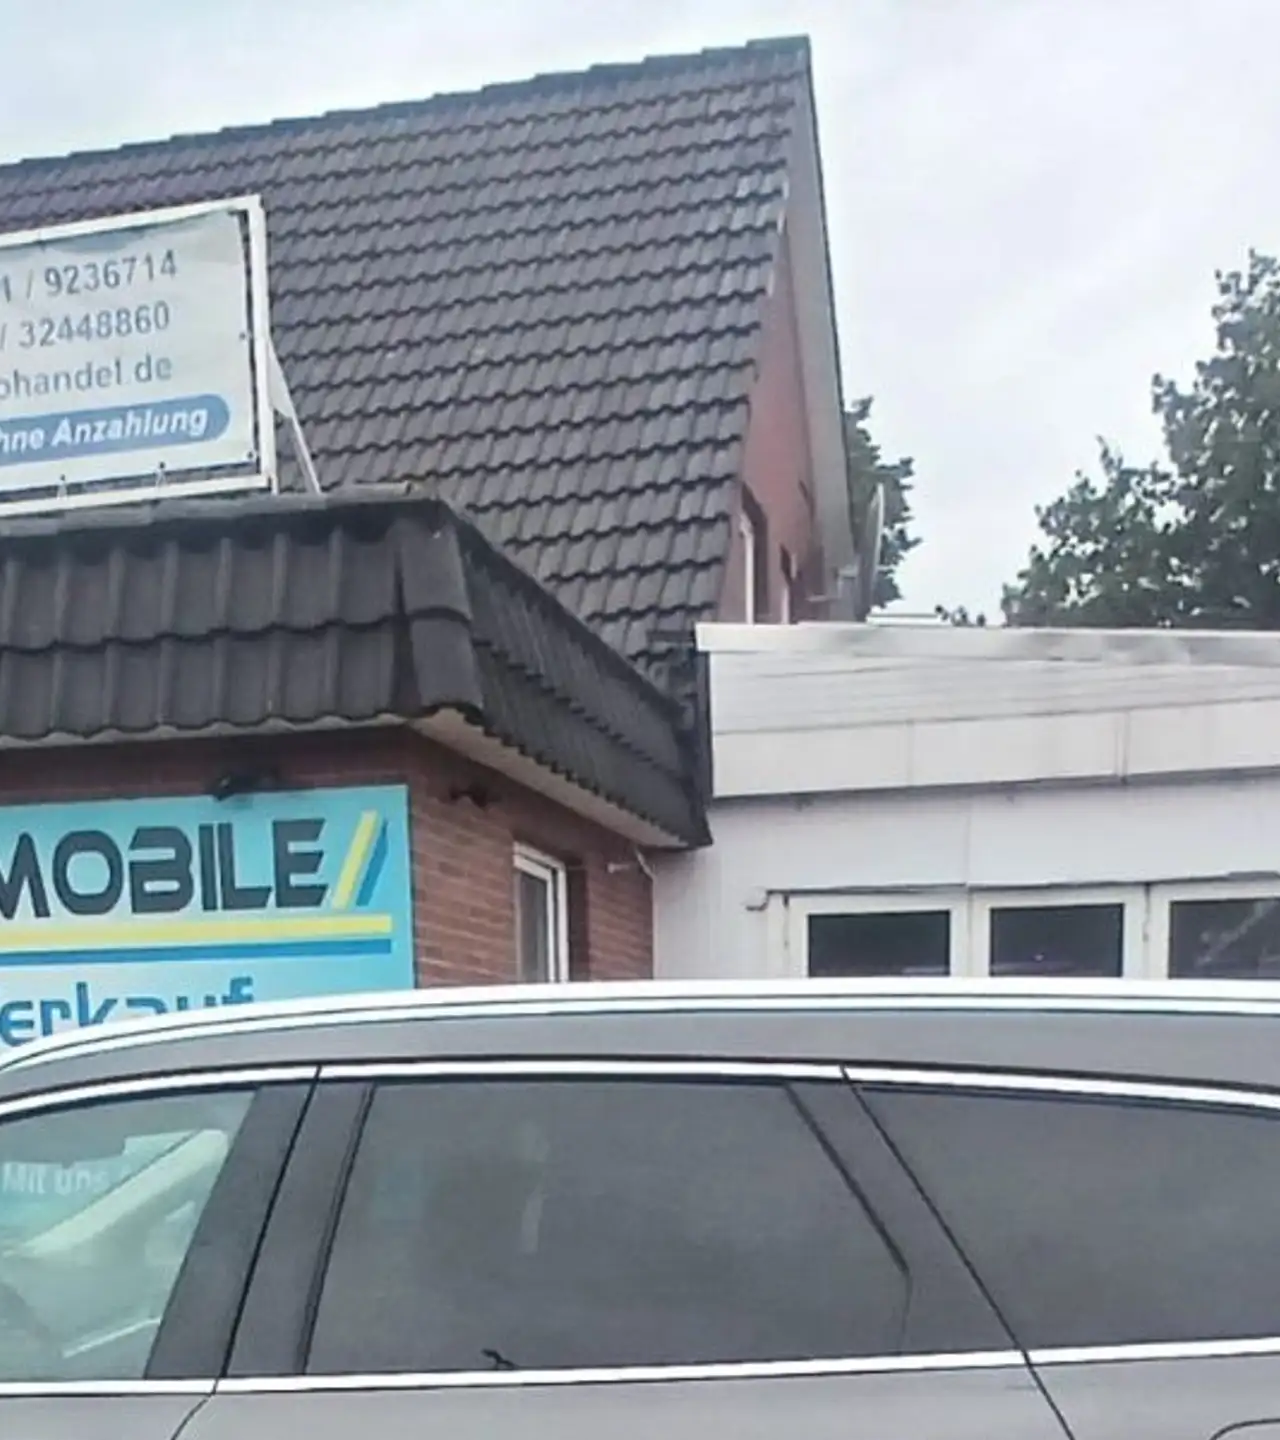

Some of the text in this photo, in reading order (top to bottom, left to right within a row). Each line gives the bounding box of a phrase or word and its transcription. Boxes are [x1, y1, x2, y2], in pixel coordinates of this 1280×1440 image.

[44, 249, 177, 298] 9236714
[20, 300, 170, 348] 32448860
[51, 405, 210, 446] Anzahlung
